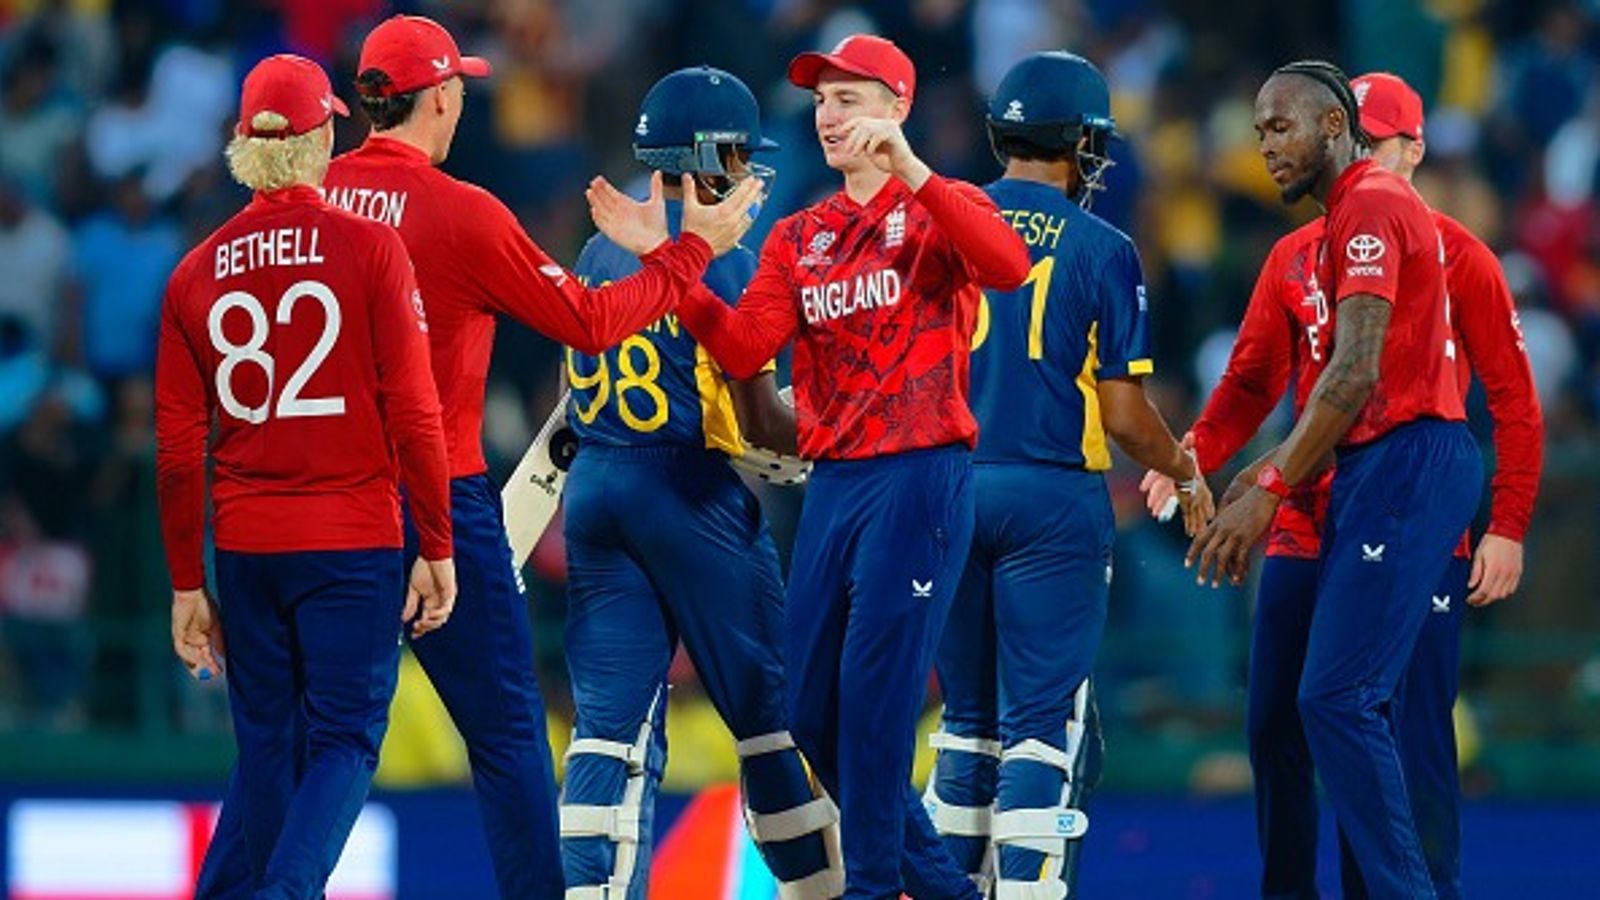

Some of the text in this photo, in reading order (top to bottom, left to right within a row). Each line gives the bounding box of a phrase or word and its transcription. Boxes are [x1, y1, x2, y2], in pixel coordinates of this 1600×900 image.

[319, 186, 408, 228] ANTON
[214, 227, 325, 280] BETHELL
[802, 269, 900, 325] ENGLAND
[208, 280, 346, 424] 82
[566, 334, 669, 432] 98
